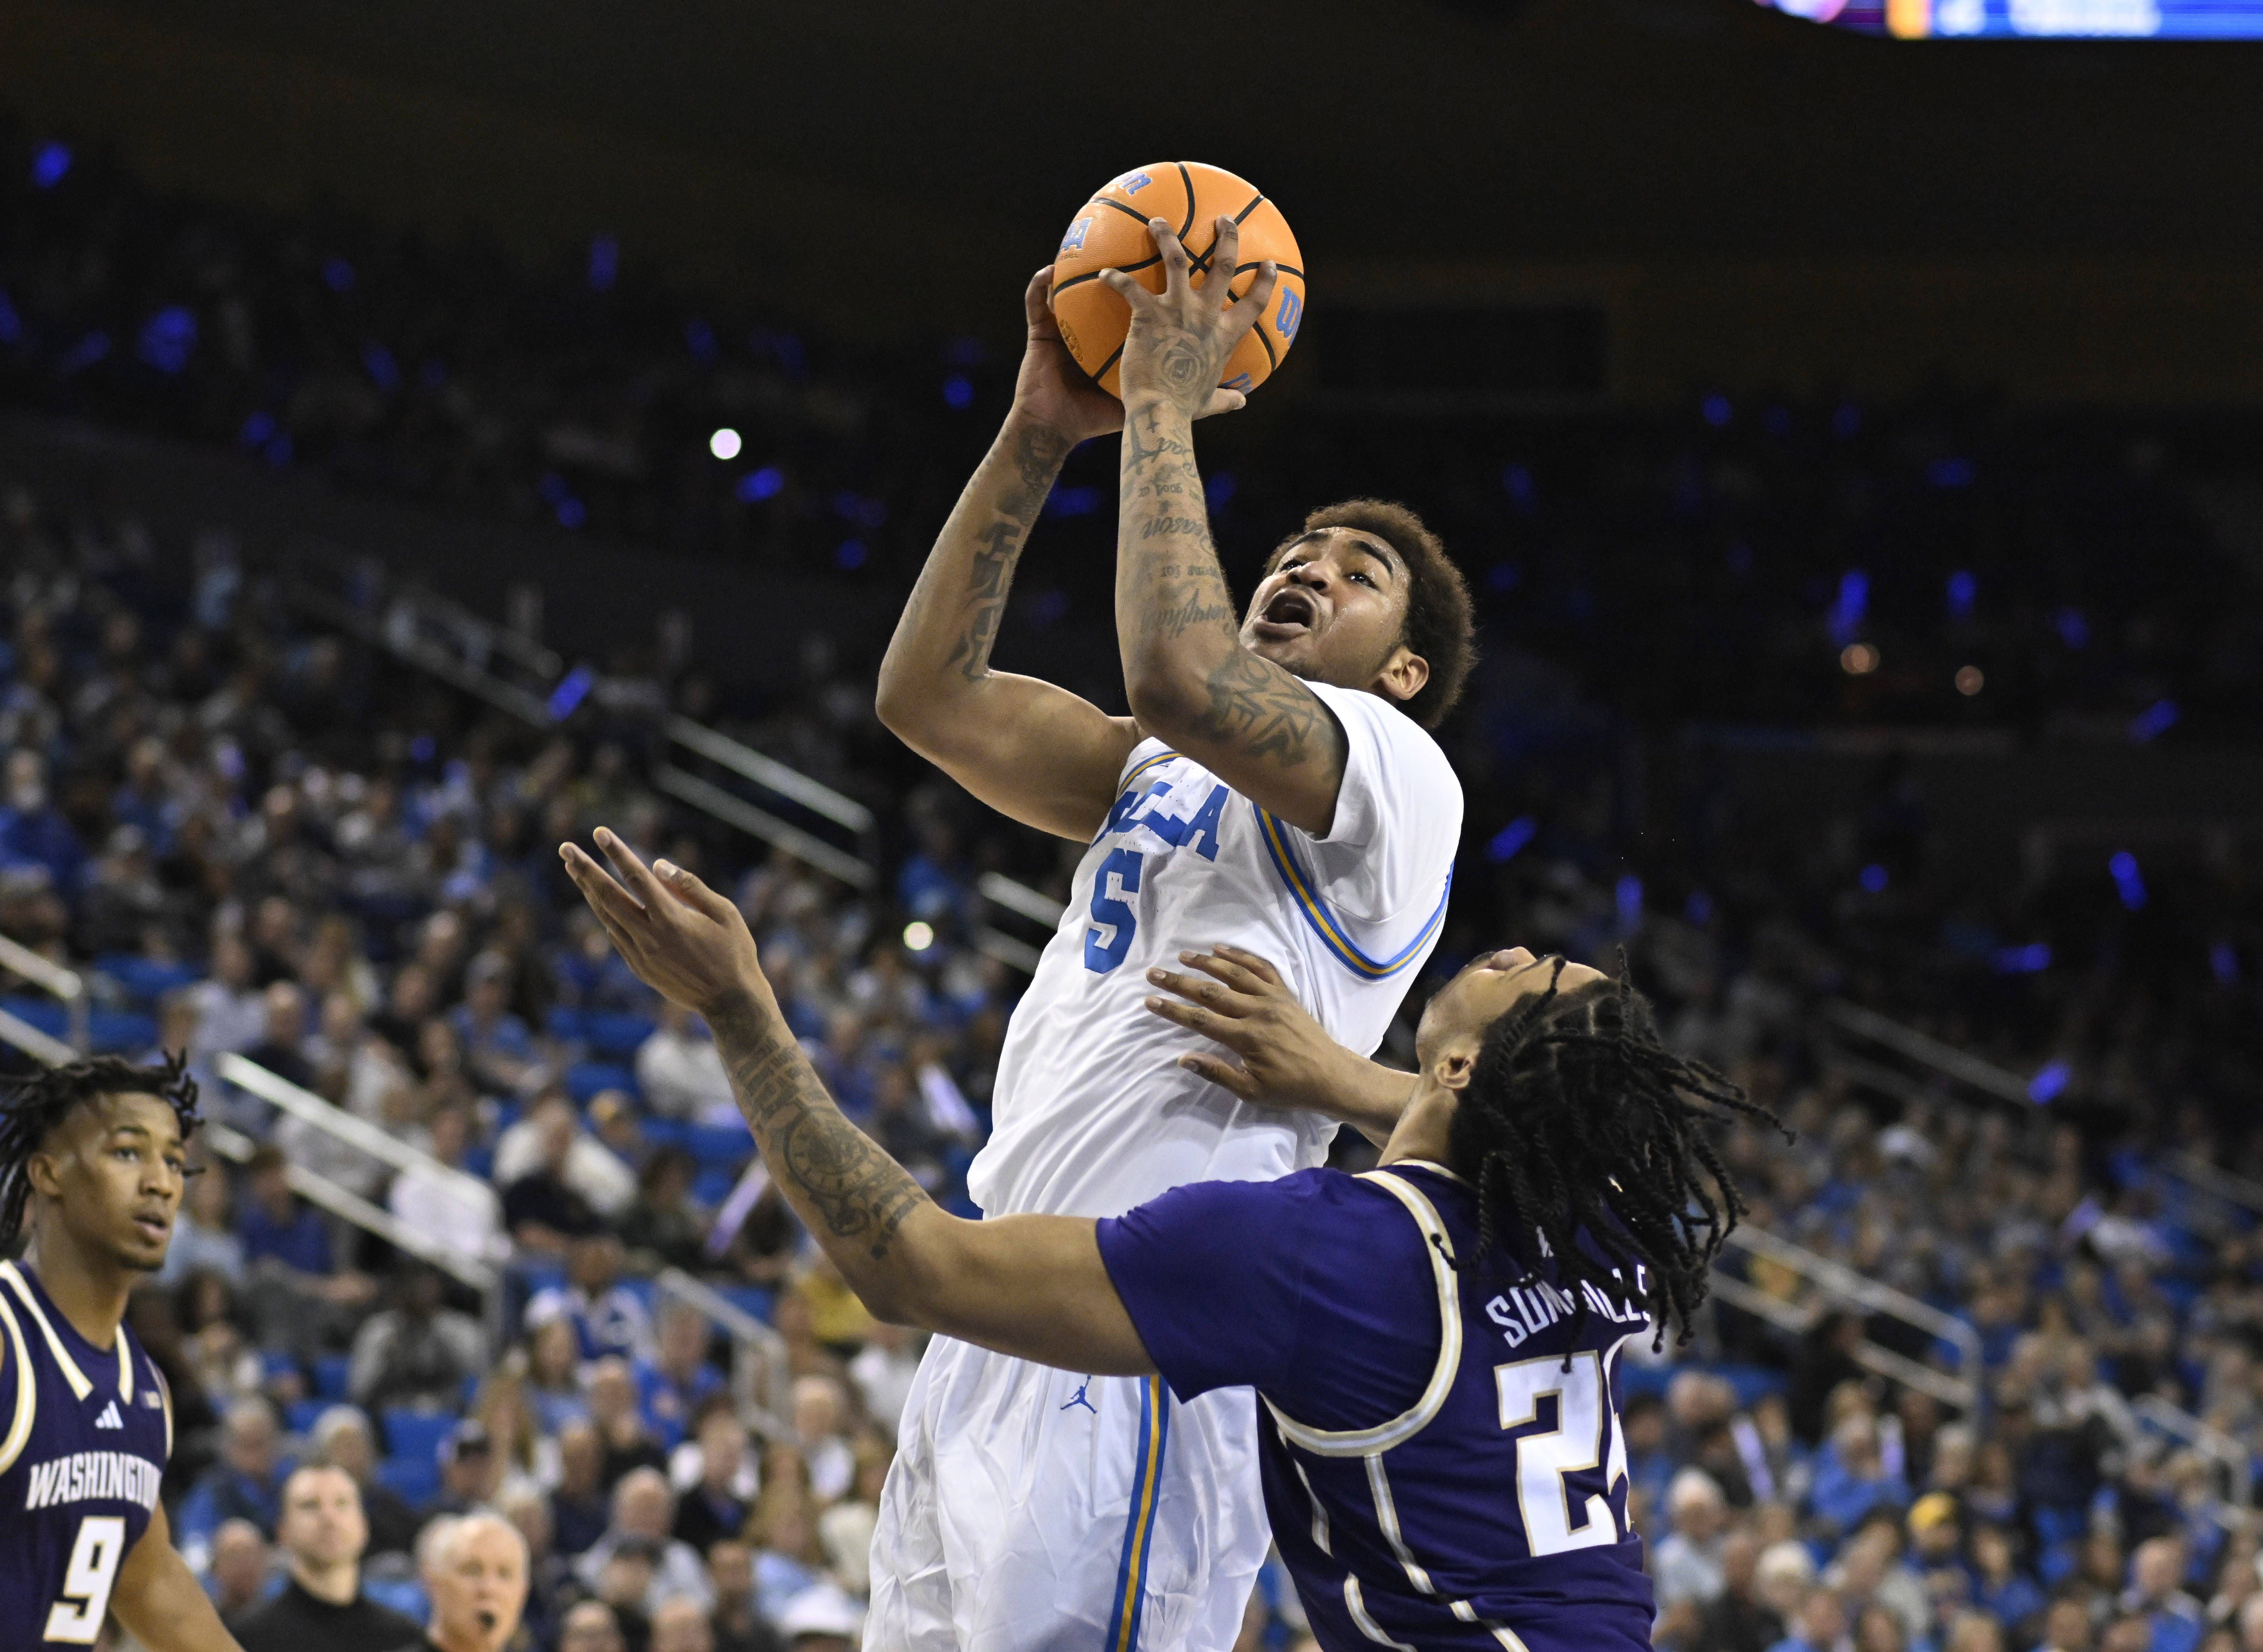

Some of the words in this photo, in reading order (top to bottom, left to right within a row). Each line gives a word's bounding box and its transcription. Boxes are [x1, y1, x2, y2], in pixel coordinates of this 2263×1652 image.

[1084, 848, 1144, 974] 5
[1494, 1334, 1635, 1557] 2
[43, 1516, 126, 1645] 9
